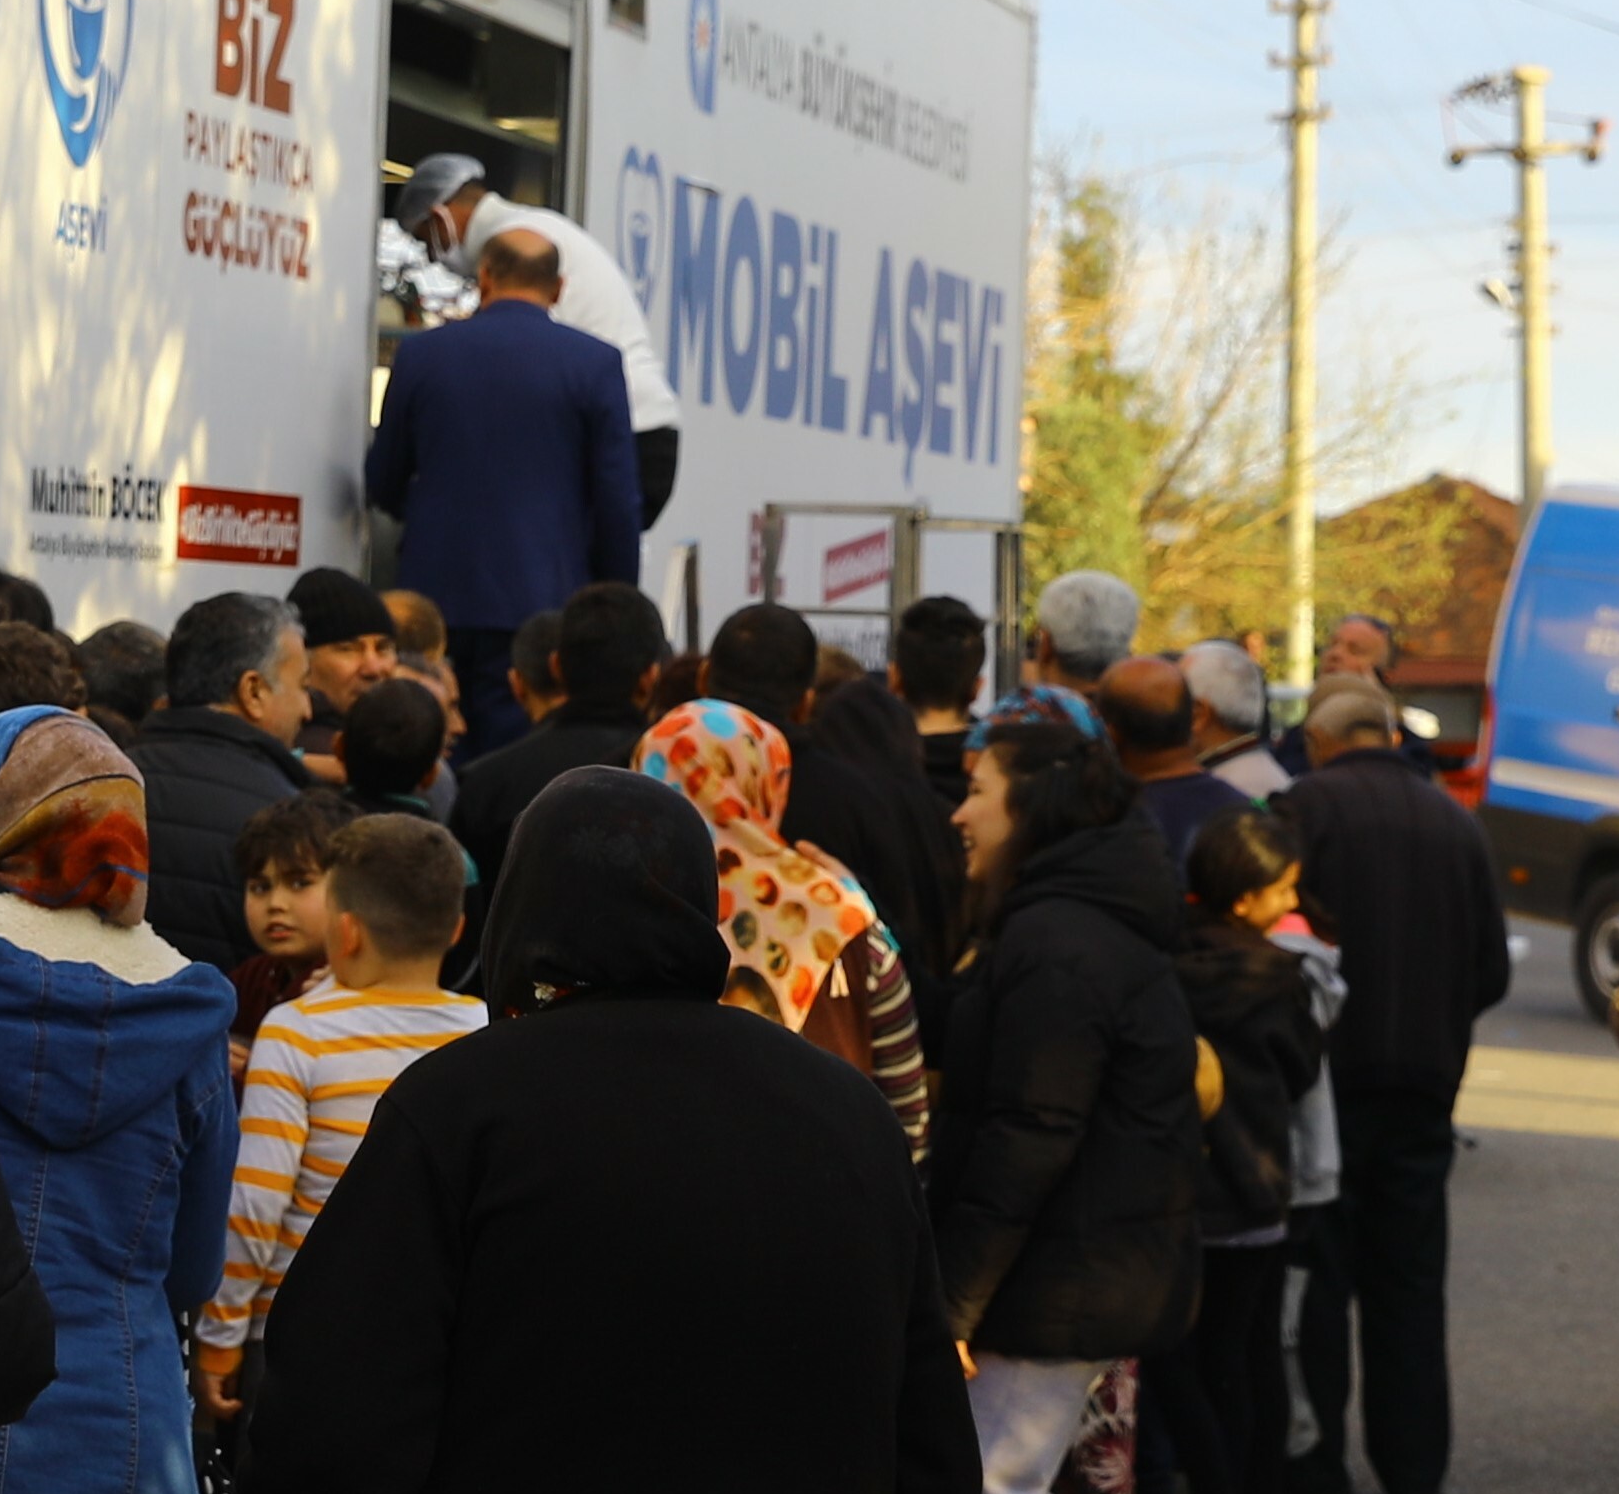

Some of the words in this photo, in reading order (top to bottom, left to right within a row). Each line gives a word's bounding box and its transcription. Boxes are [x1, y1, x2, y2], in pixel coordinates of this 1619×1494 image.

[183, 110, 315, 199] PAYLAŞTIKÇA
[182, 189, 312, 282] GÜÇLÜYÜZ
[859, 244, 1006, 489] AŞEVİ
[30, 466, 107, 518] Muhittin
